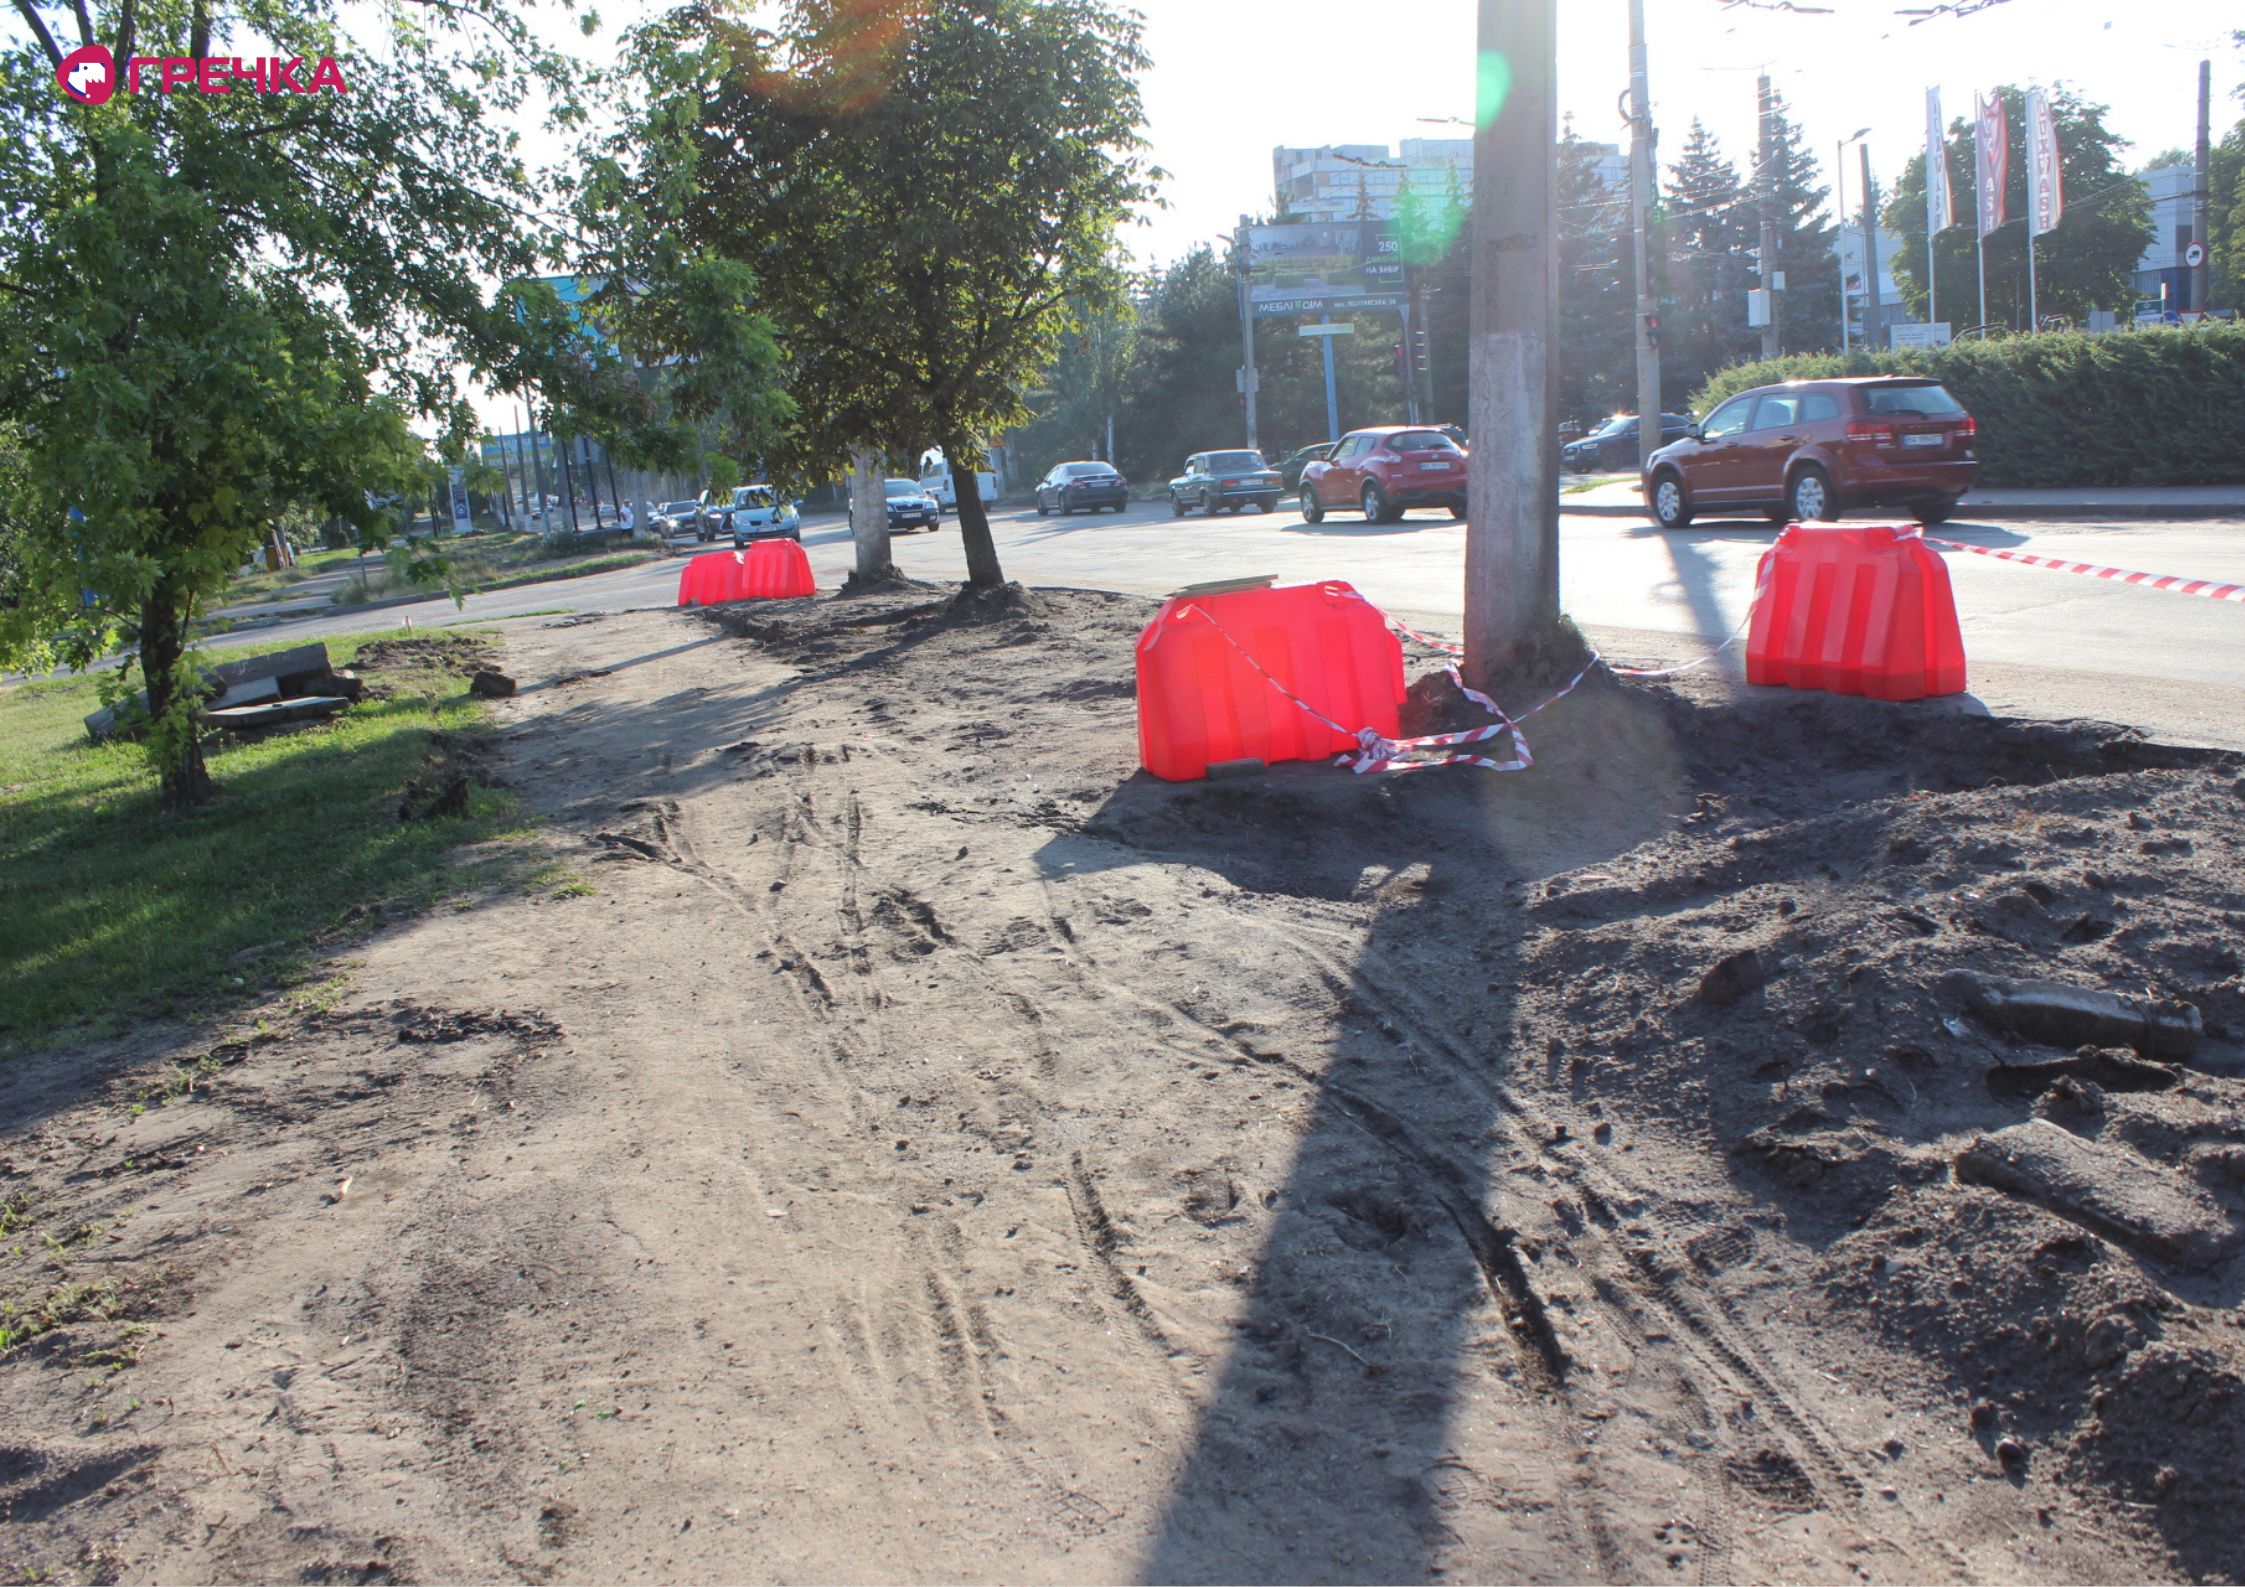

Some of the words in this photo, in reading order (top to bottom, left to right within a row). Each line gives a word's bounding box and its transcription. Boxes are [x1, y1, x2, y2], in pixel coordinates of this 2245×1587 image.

[1378, 241, 1398, 252] 250
[1258, 302, 1293, 312] МЕБЛІ
[1302, 300, 1323, 309] ДІМ
